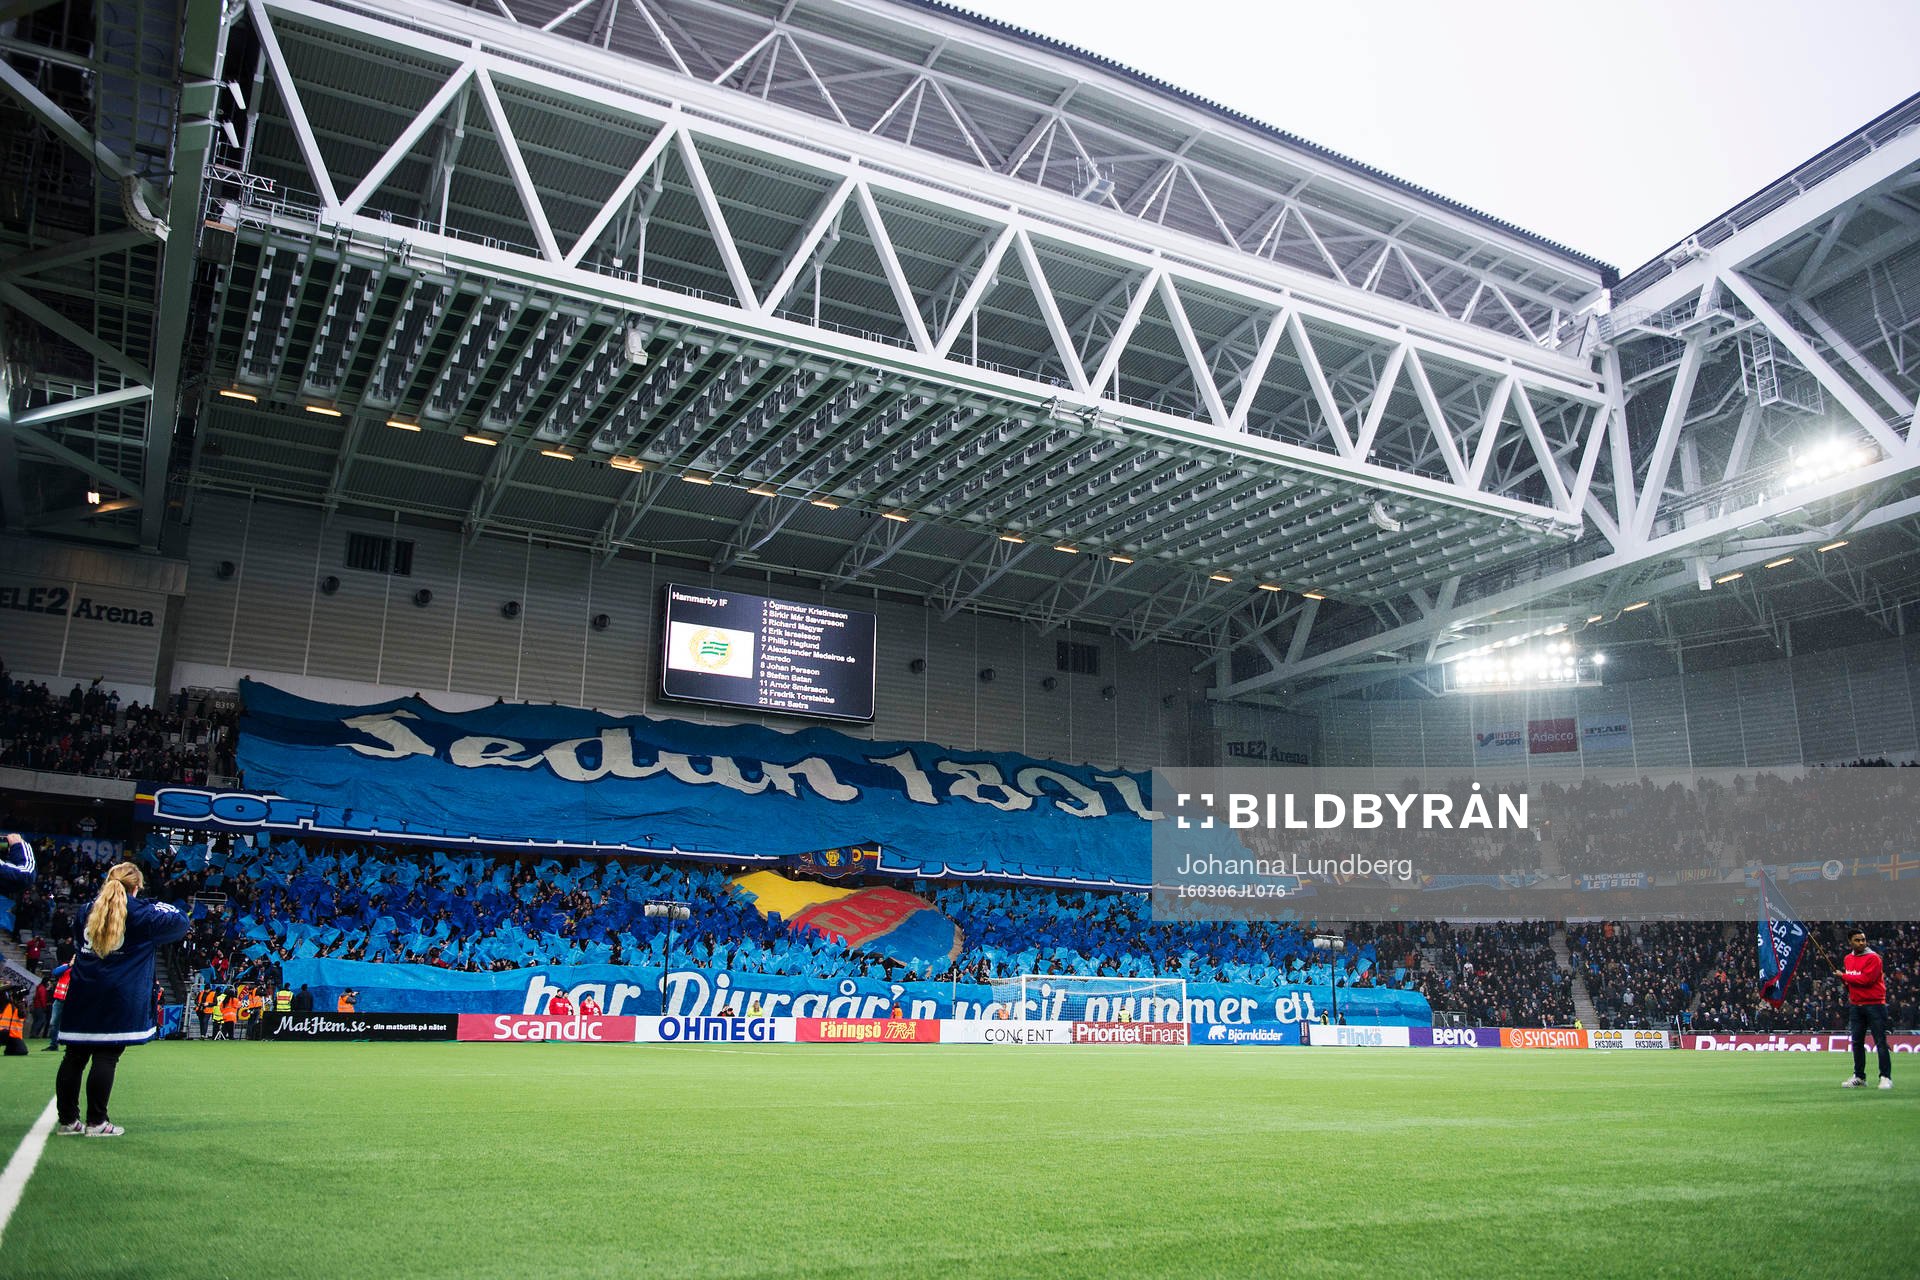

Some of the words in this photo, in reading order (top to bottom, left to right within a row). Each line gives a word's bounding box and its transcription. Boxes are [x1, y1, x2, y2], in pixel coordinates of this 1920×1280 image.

[672, 592, 717, 607] Hammarby
[720, 598, 728, 606] IF
[0, 587, 70, 616] ELE2
[73, 597, 154, 627] Arena
[769, 610, 789, 619] Birkir
[808, 608, 848, 620] Kristinsson
[768, 628, 783, 636] Erik
[769, 619, 796, 629] Richard
[798, 623, 824, 634] Magyar
[790, 640, 820, 650] Haglund
[766, 663, 789, 671] Johan
[790, 666, 820, 675] Persson
[766, 671, 790, 680] Stefan
[770, 690, 795, 699] Fredrik
[215, 701, 235, 710] B319
[770, 698, 786, 706] Lars
[1495, 731, 1520, 739] INTER
[1532, 732, 1574, 744] Adecco
[1495, 738, 1521, 746] SPORT
[1227, 741, 1267, 760] TELE2
[1270, 746, 1308, 765] Arena
[1587, 879, 1618, 889] LET'S
[522, 975, 641, 1016] har
[1085, 996, 1258, 1024] nummer
[1275, 991, 1321, 1024] ett
[418, 1024, 428, 1032] på
[493, 1015, 603, 1040] Scandic
[820, 1021, 881, 1039] Färingsö
[884, 1021, 917, 1039] TRÄ
[1076, 1023, 1141, 1042] Prioritet
[1143, 1024, 1185, 1042] Finans
[1228, 1028, 1283, 1043] Björnkläder
[1337, 1027, 1382, 1045] Flinks
[1525, 1031, 1579, 1046] SYNSAM
